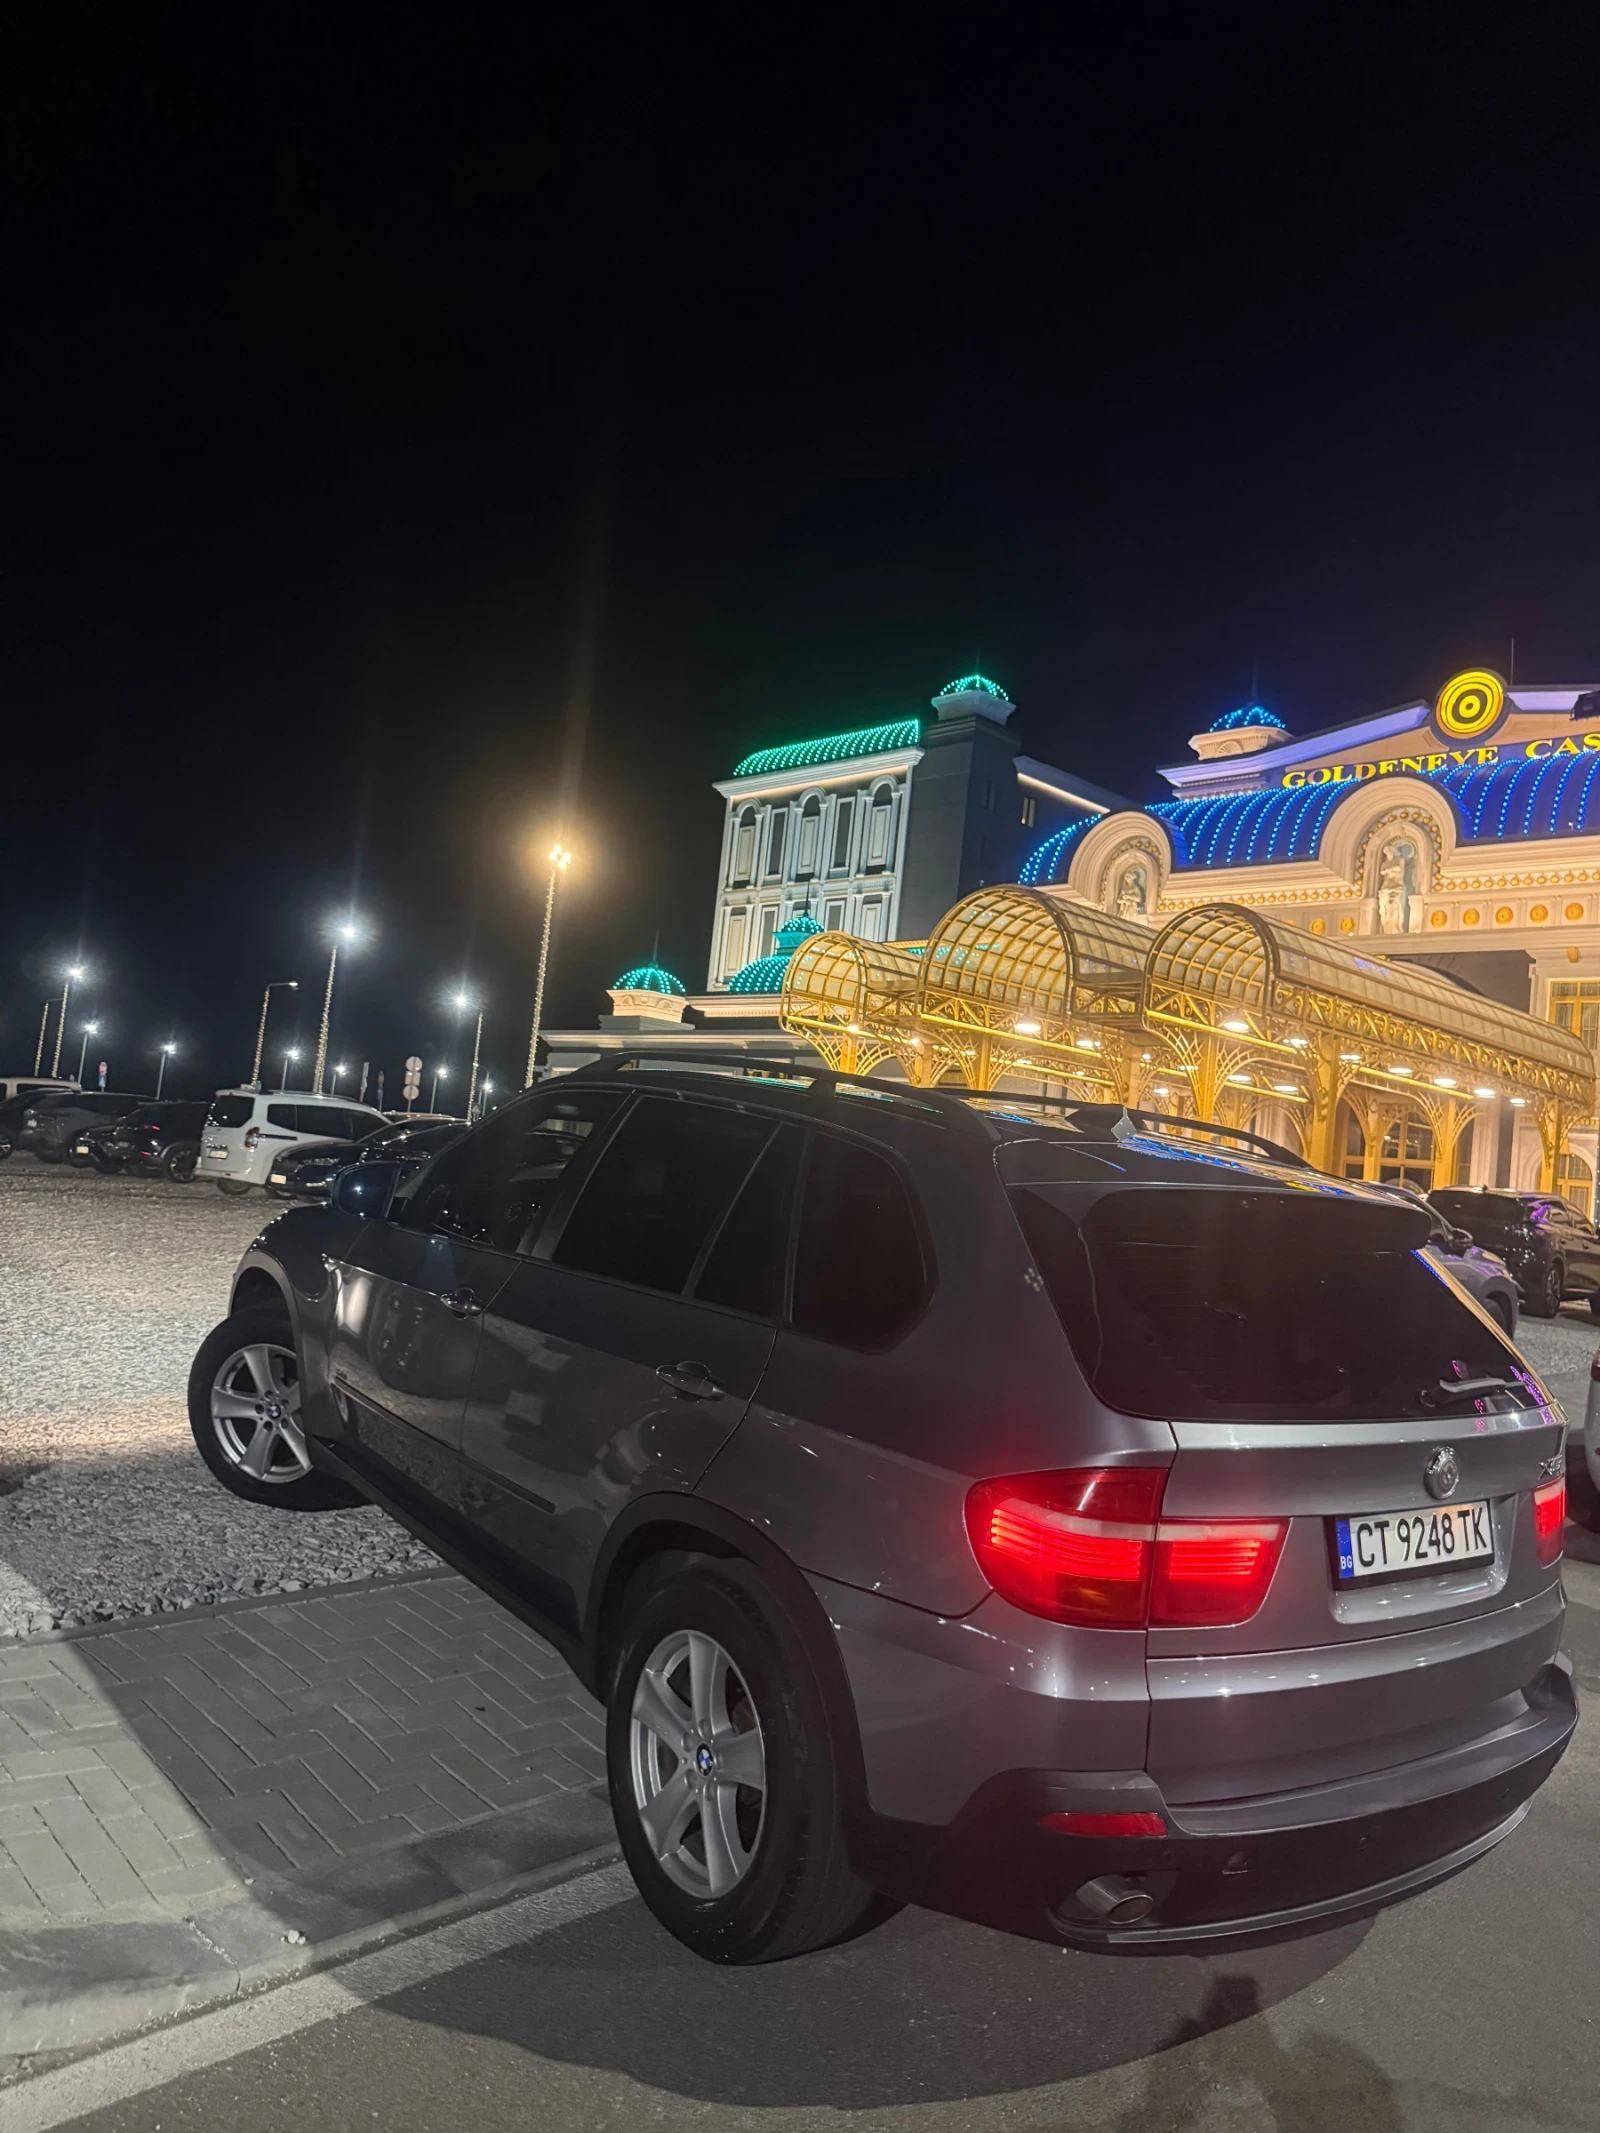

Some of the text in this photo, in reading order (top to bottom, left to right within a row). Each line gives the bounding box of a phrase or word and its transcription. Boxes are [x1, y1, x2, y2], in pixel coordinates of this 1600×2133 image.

[1282, 746, 1498, 788] GOLDENEYE
[1357, 1507, 1487, 1567] CT 9248 TK
[1340, 1555, 1353, 1570] BG
